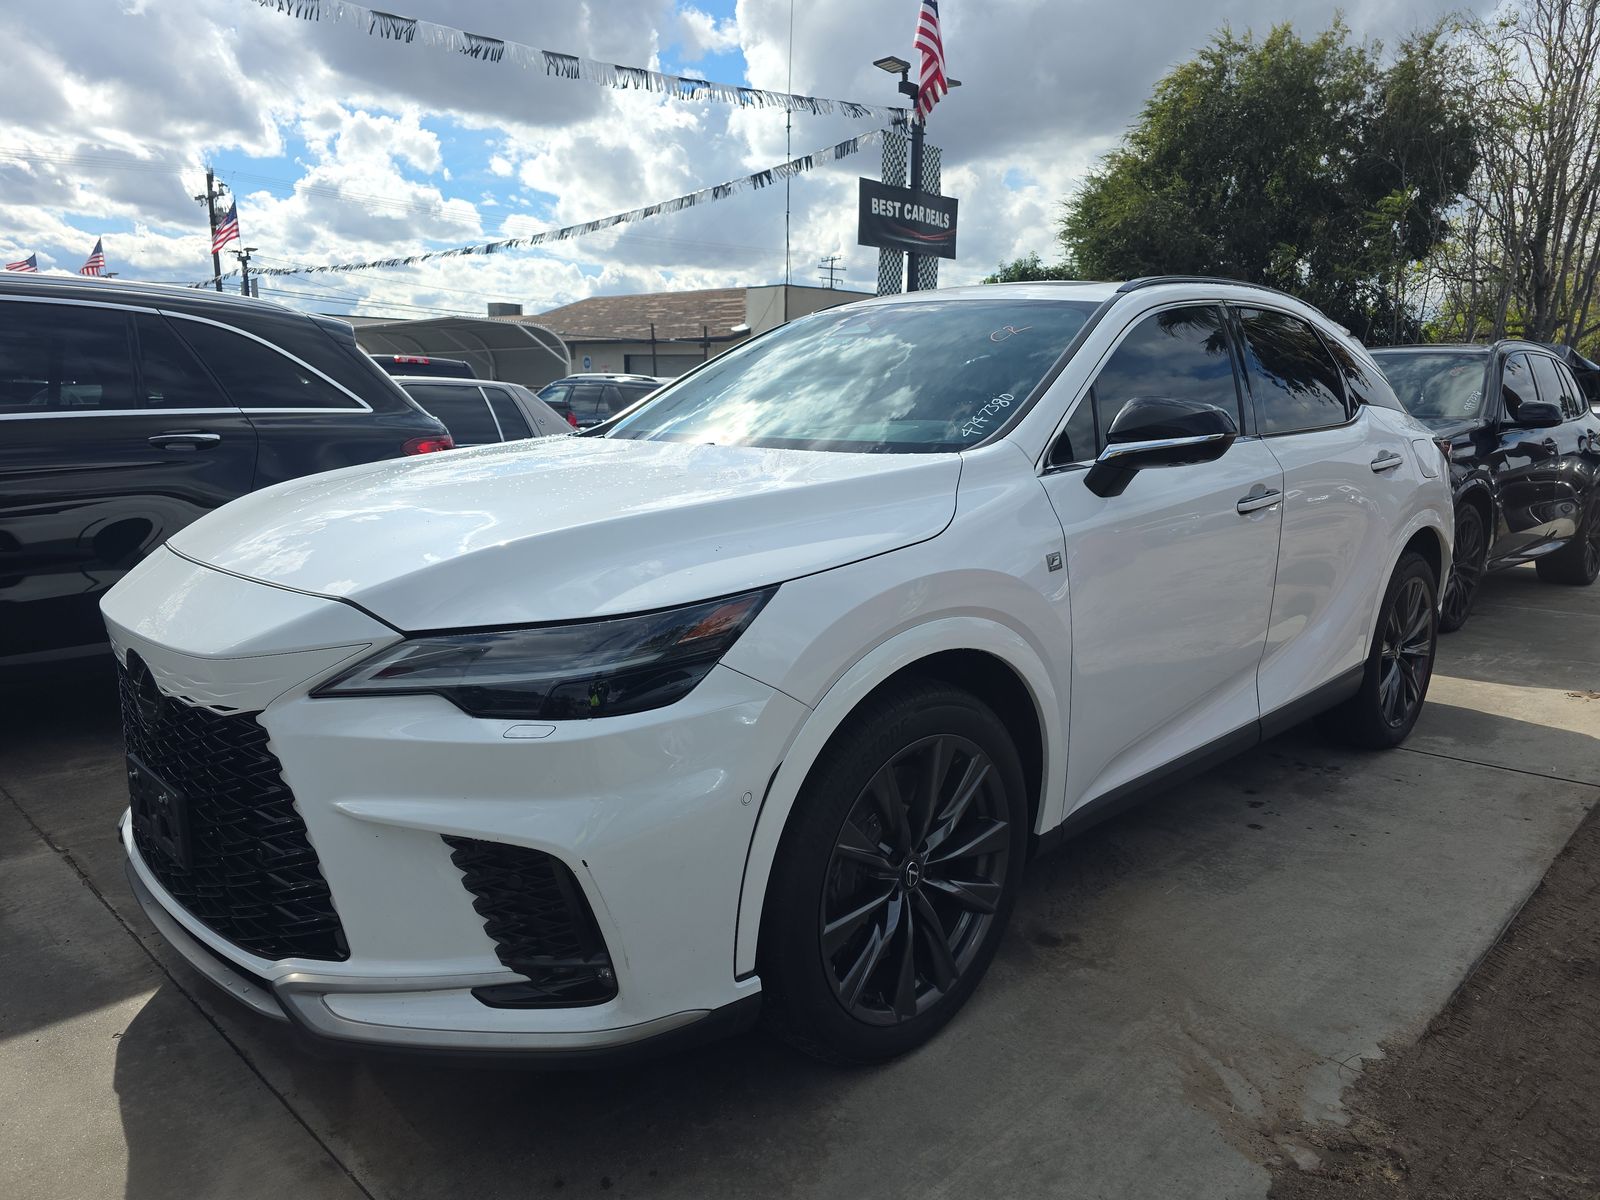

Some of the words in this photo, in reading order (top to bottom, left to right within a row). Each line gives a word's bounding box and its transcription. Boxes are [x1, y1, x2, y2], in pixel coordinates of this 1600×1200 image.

[872, 198, 901, 218] BEST
[904, 203, 924, 221] CAR
[925, 208, 950, 229] DEALS
